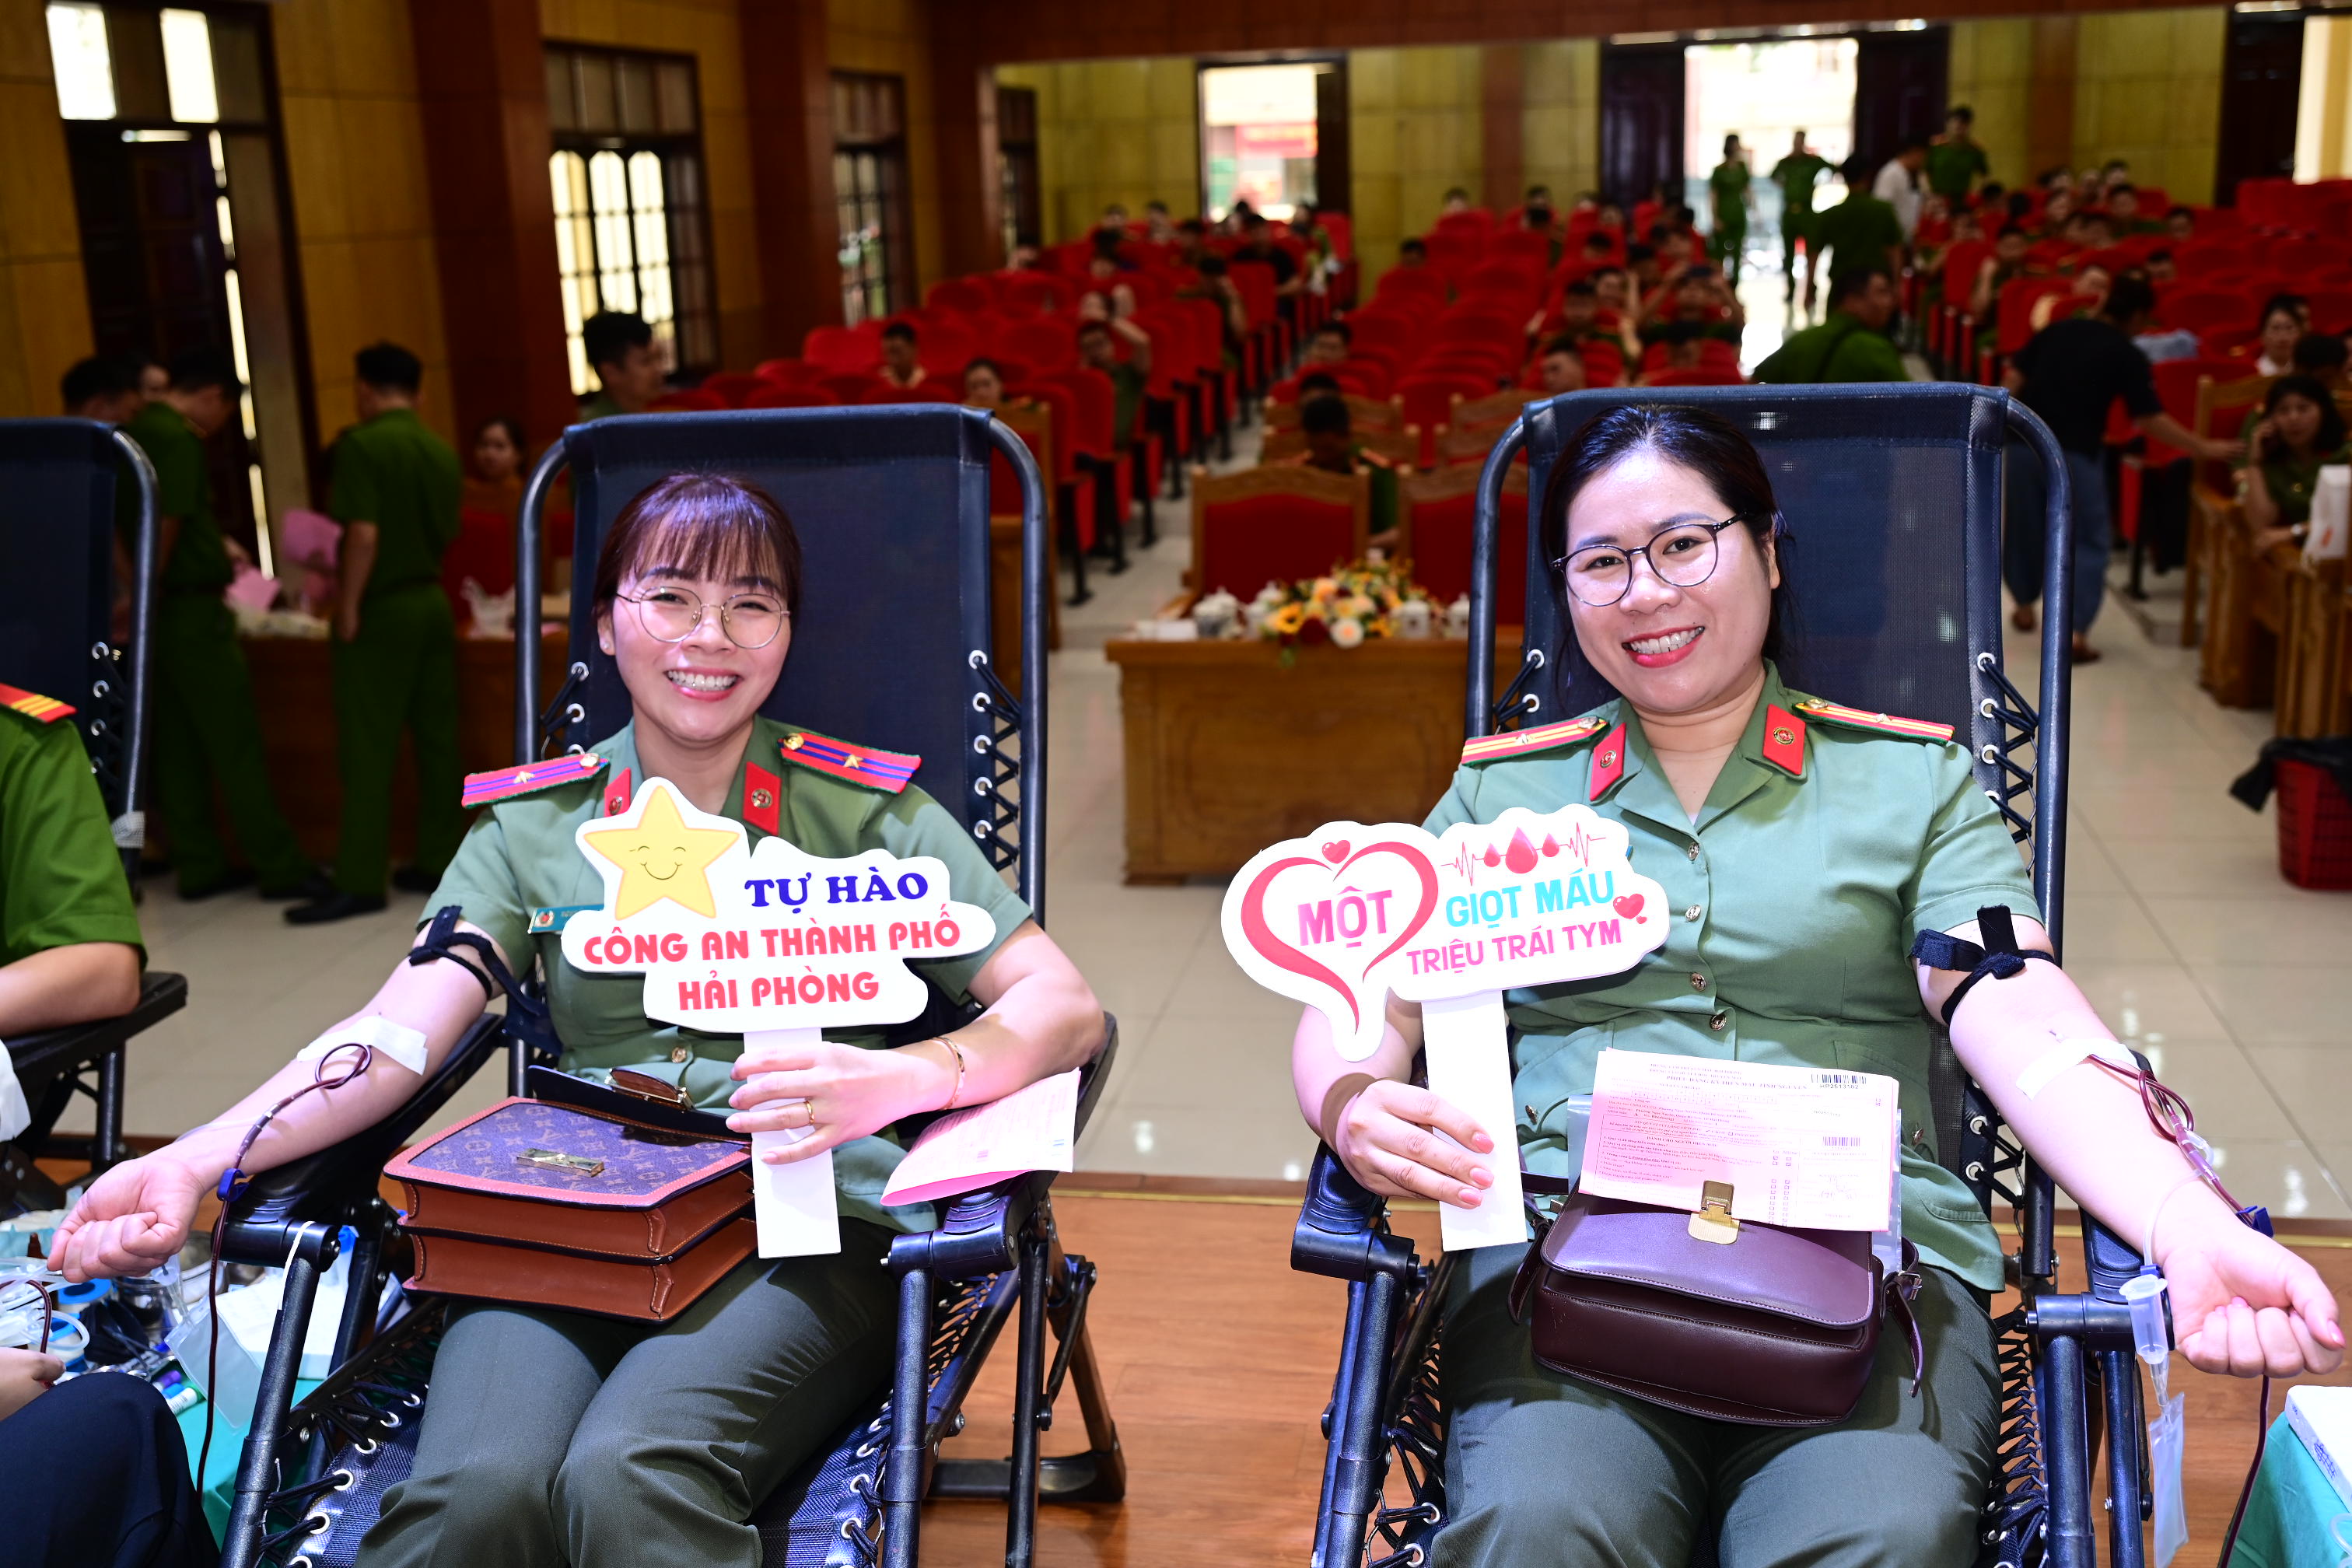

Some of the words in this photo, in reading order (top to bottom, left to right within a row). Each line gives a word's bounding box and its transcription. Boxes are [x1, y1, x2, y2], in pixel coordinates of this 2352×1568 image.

[744, 872, 811, 914] TỰ
[826, 866, 929, 905] HÀO
[1297, 885, 1393, 948] MỘT
[1445, 886, 1522, 929] GIỌT
[1535, 867, 1615, 914] MÁU
[583, 926, 688, 965] CÔNG
[701, 930, 750, 961] AN
[761, 917, 877, 957] THÀNH
[889, 903, 961, 950] PHỐ
[1406, 938, 1484, 975] TRIỆU
[1491, 926, 1554, 962] TRÁI
[1562, 919, 1622, 950] TYM
[678, 970, 739, 1011] HẢI
[751, 965, 880, 1007] PHÒNG
